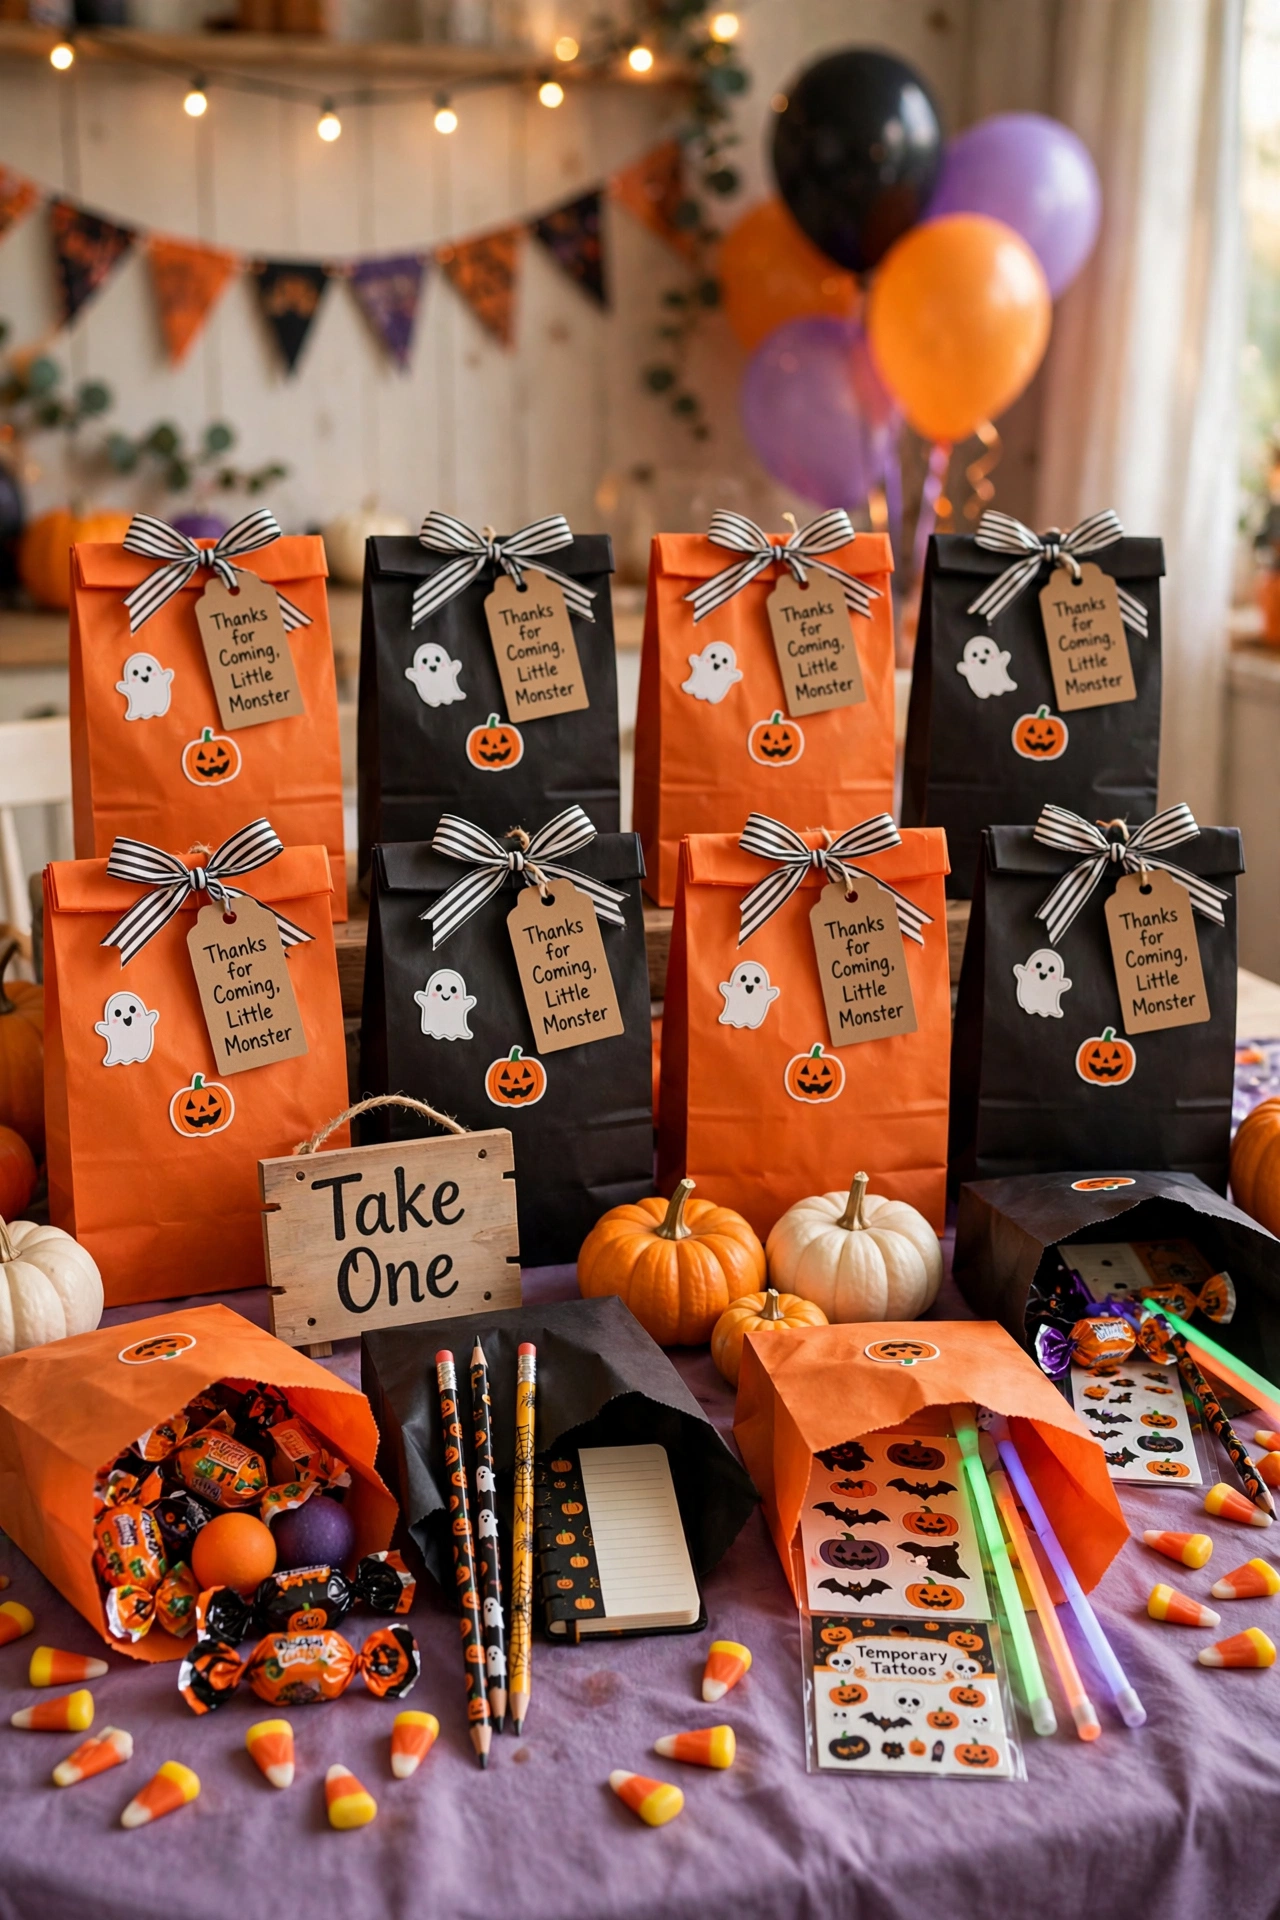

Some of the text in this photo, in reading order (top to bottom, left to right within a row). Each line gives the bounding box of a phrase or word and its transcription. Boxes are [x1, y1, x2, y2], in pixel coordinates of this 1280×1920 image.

[498, 603, 554, 626] Thanks
[779, 601, 835, 623] Thanks
[1052, 596, 1106, 618] Thanks
[209, 607, 268, 630] Thanks
[799, 621, 822, 637] for
[1071, 616, 1094, 633] for
[231, 628, 255, 646] for
[518, 624, 542, 641] for
[1058, 633, 1116, 652] Coming,
[218, 645, 280, 667] Coming,
[506, 641, 565, 662] Coming,
[787, 637, 845, 658] Coming,
[516, 661, 559, 683] Little
[797, 657, 838, 679] Little
[1067, 653, 1108, 674] Little
[230, 666, 274, 690] Little
[1064, 674, 1122, 696] Monster
[228, 688, 290, 713] Monster
[515, 682, 574, 706] Monster
[795, 678, 853, 701] Monster
[823, 915, 885, 940] Thanks
[1118, 907, 1179, 930] Thanks
[522, 918, 584, 945] Thanks
[1139, 928, 1164, 947] for
[202, 936, 267, 964] Thanks
[545, 942, 571, 961] for
[845, 938, 871, 957] for
[1125, 947, 1188, 969] Coming,
[227, 961, 253, 981] for
[532, 960, 597, 985] Coming,
[831, 957, 895, 979] Coming,
[213, 979, 280, 1004] Coming,
[842, 979, 888, 1003] Little
[1136, 969, 1180, 992] Little
[544, 983, 591, 1009] Little
[1132, 992, 1196, 1017] Monster
[226, 1002, 274, 1029] Little
[542, 1006, 608, 1035] Monster
[839, 1003, 904, 1029] Monster
[224, 1026, 292, 1057] Monster
[310, 1166, 466, 1242] Take
[337, 1246, 460, 1314] One
[855, 1645, 948, 1666] Temporary
[870, 1661, 937, 1676] Tattoos
